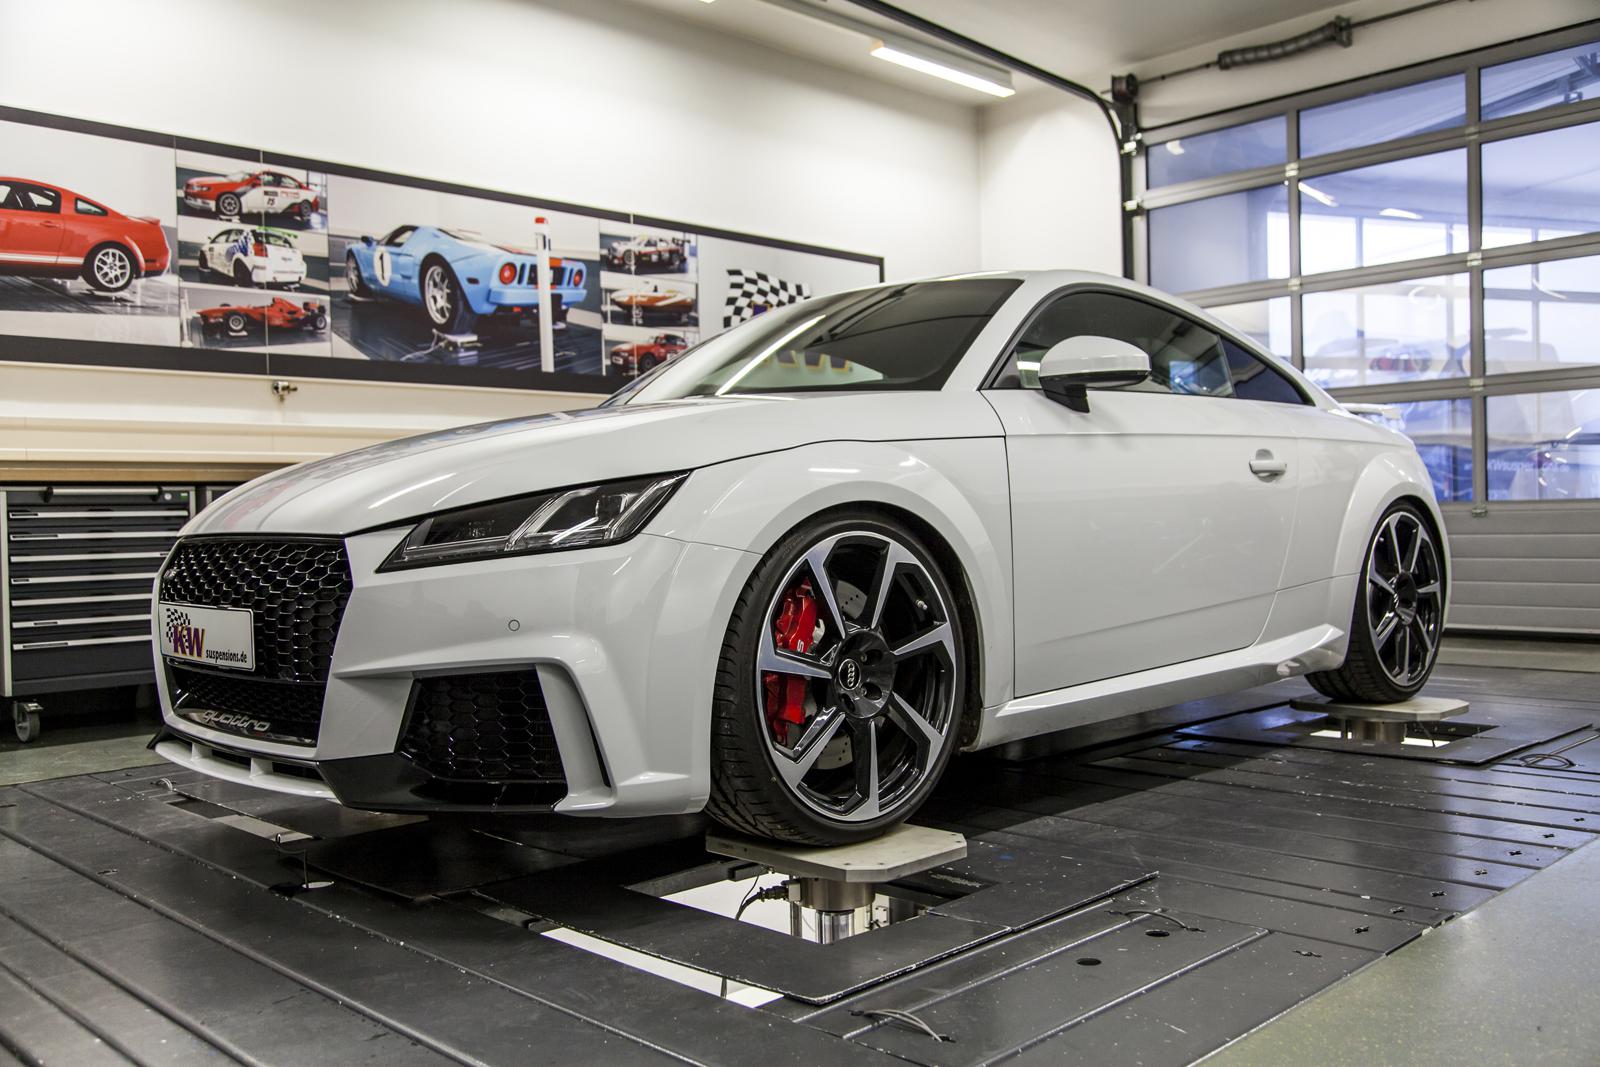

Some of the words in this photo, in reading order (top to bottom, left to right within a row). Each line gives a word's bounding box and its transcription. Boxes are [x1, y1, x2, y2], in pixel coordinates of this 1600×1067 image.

[379, 253, 385, 280] 1
[173, 625, 205, 658] KW
[206, 649, 247, 663] suspensions.de
[204, 710, 271, 731] quattro
